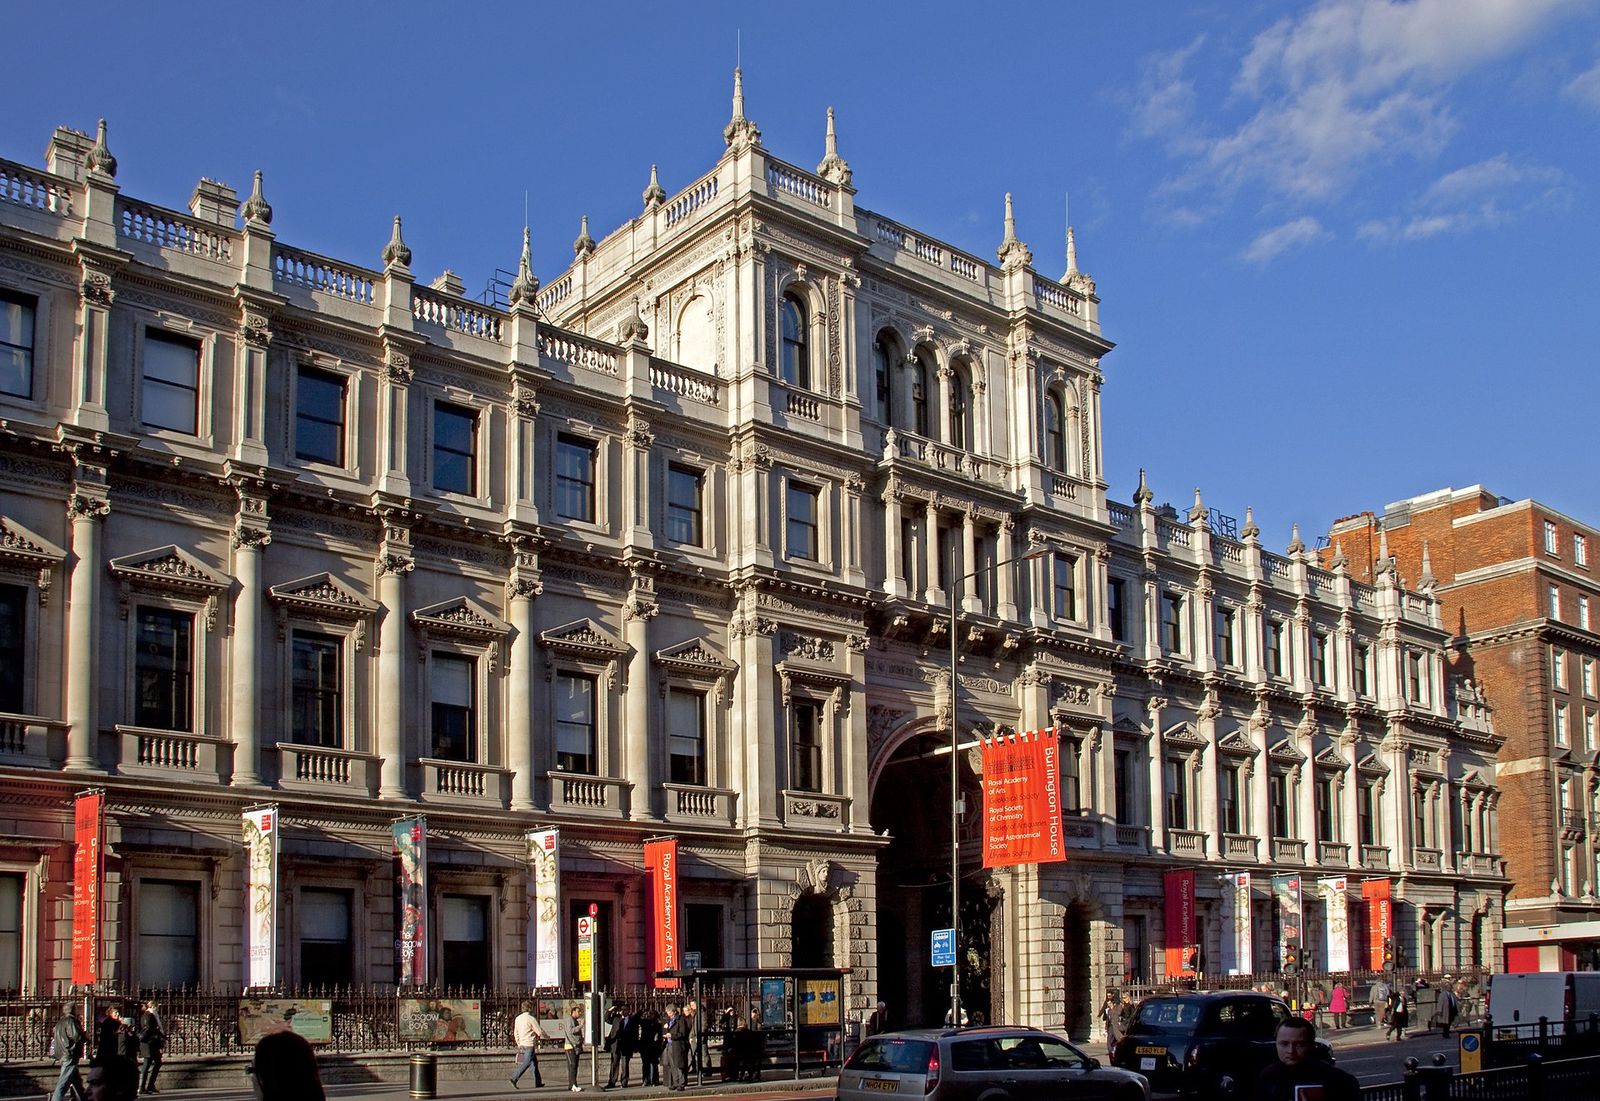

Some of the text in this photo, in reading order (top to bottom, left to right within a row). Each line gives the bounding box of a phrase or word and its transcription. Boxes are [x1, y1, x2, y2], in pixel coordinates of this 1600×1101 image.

[1004, 776, 1028, 785] Academy
[1045, 747, 1058, 855] Burlington House
[989, 807, 1003, 815] Royal
[996, 813, 1024, 821] Chemistry
[990, 831, 1041, 844] Royal Astronomical
[990, 843, 1008, 851] Society
[1181, 880, 1190, 900] Royal
[661, 853, 674, 964] Royal Academy of Arts
[1182, 902, 1190, 935] Academy
[401, 1003, 420, 1013] The
[401, 1013, 440, 1023] Glasgow
[408, 1021, 429, 1031] Boys
